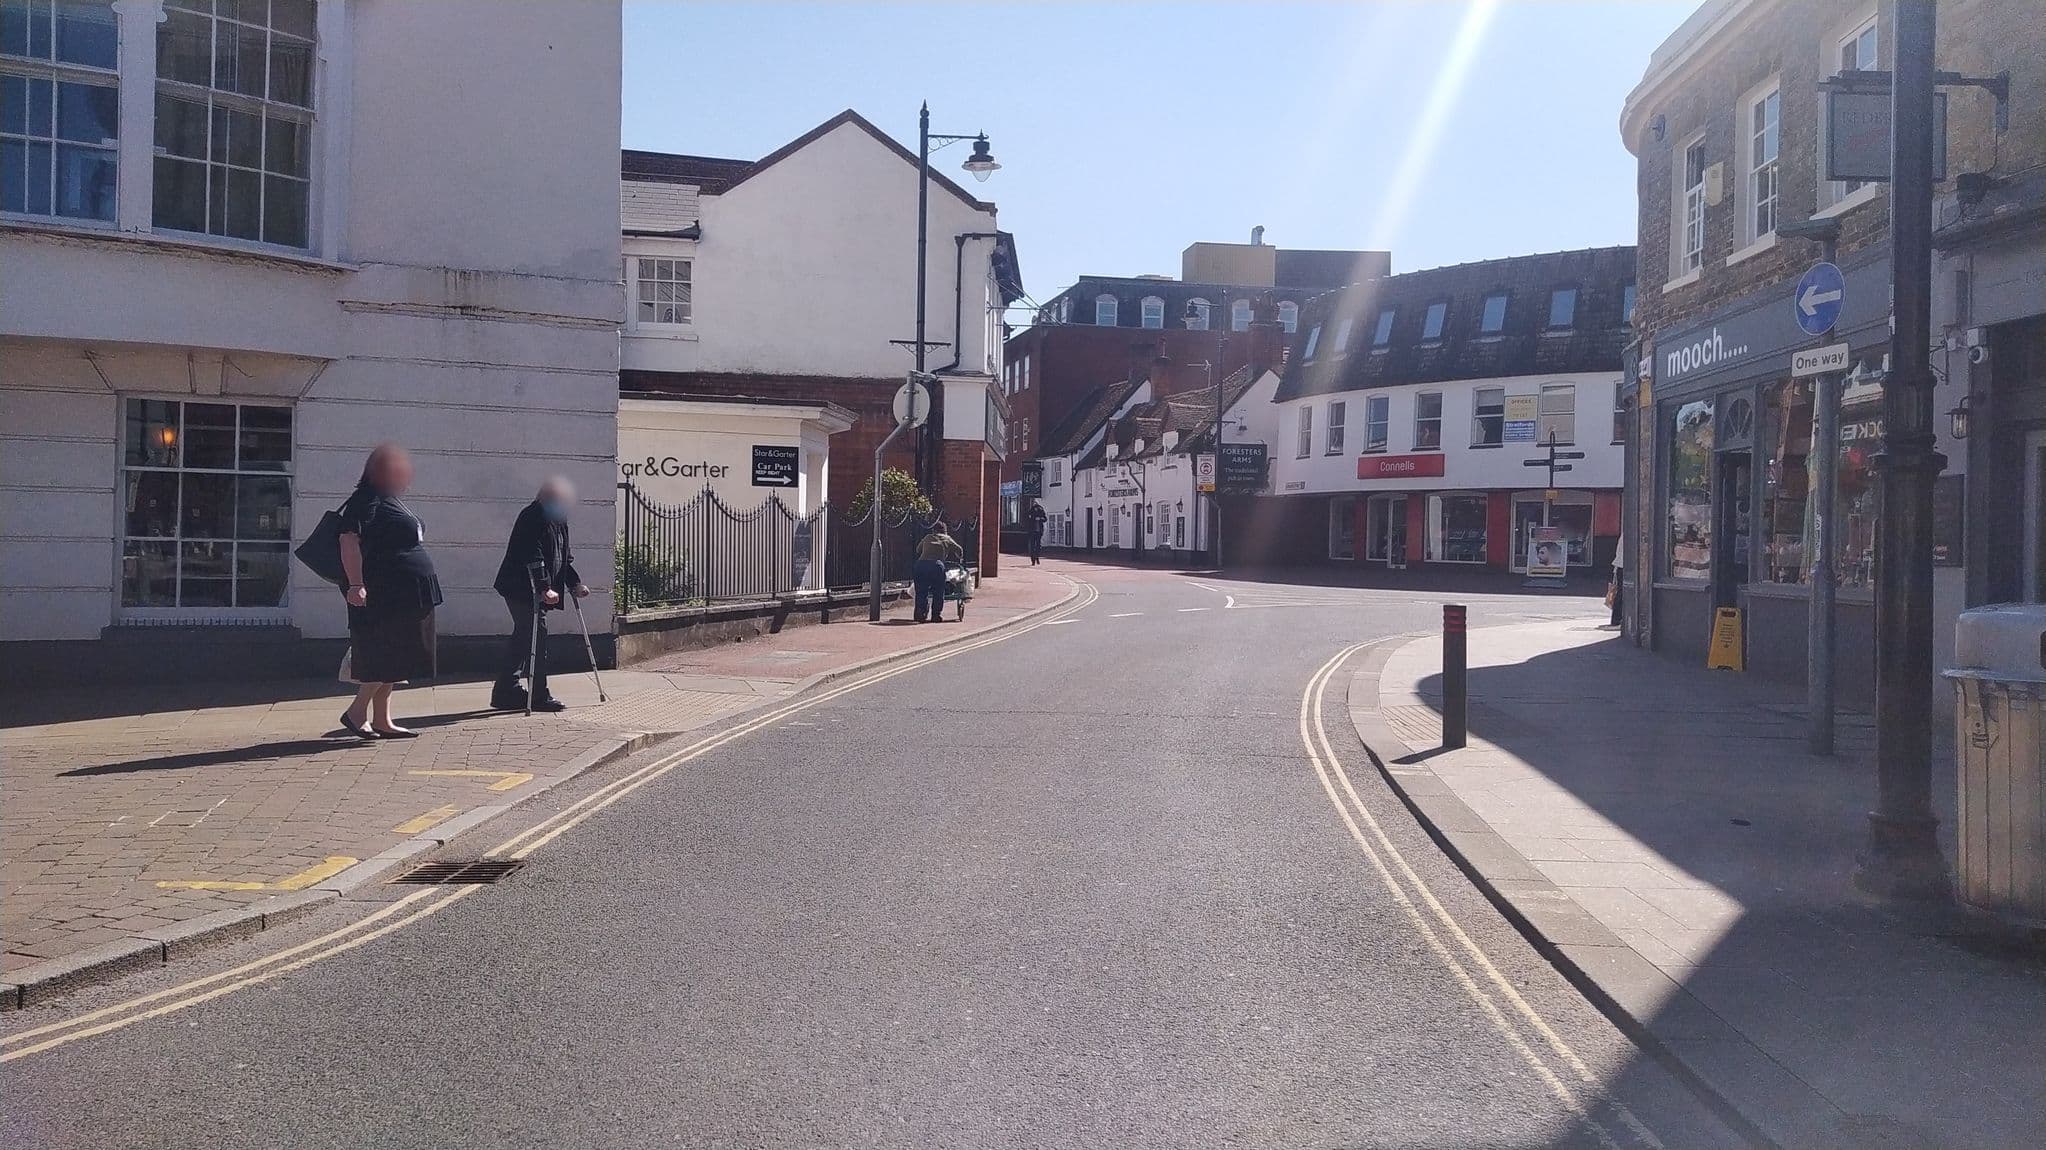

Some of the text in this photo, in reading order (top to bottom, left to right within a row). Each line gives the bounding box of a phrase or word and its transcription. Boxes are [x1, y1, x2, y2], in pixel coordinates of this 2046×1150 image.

[1795, 352, 1845, 370] One way
[754, 449, 796, 458] Star&Garter
[1222, 448, 1262, 456] FORESTERS
[618, 456, 729, 478] ar&Garter
[757, 462, 793, 471] Car Park
[1380, 461, 1415, 471] Connells
